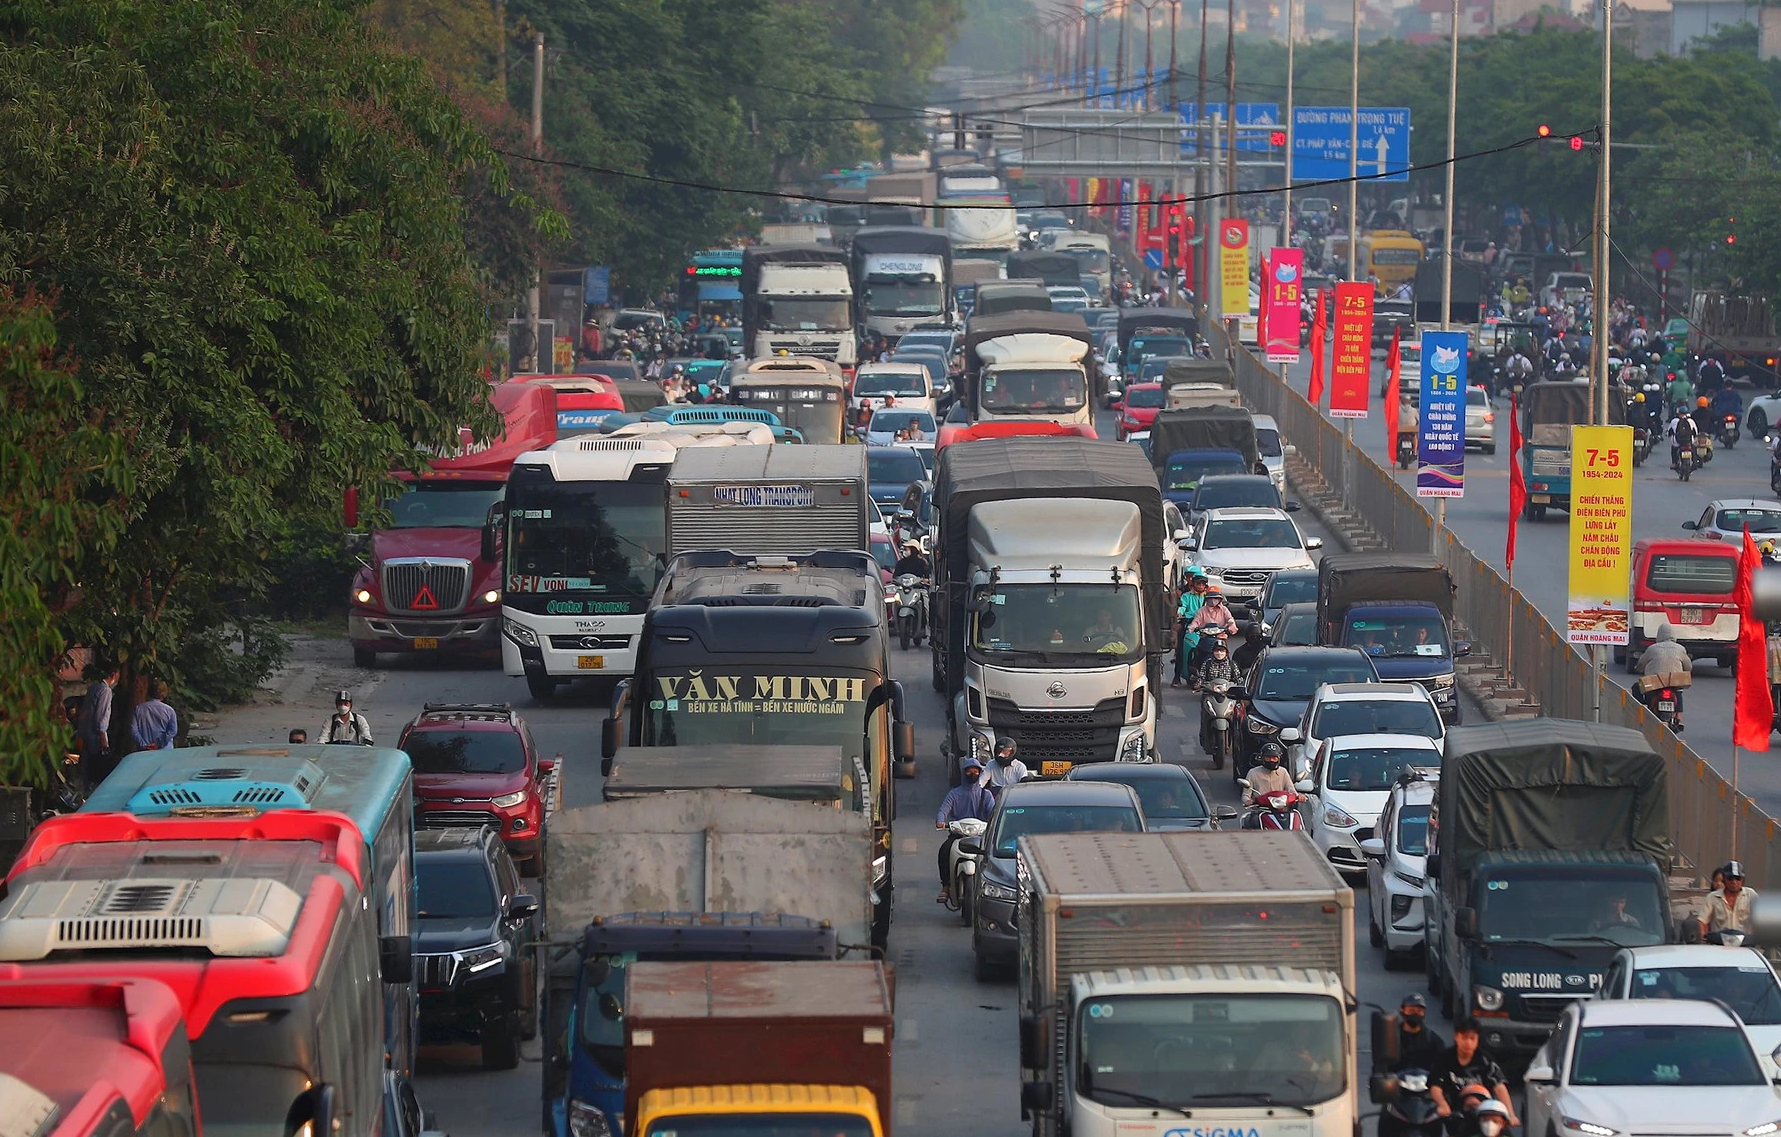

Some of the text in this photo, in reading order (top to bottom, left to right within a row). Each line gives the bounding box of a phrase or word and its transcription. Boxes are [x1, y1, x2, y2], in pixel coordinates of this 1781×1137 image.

[1384, 126, 1395, 134] km
[1335, 150, 1346, 160] km
[1274, 284, 1297, 300] 1-5
[1344, 296, 1365, 308] 7-5
[1431, 375, 1457, 390] 1-5
[1430, 402, 1455, 412] NHIỆT LIỆT
[1428, 412, 1457, 421] CHÀO MỪNG
[1425, 432, 1460, 440] NGÀY QUỐC TẾ
[1438, 442, 1452, 451] ĐỘNG
[1586, 449, 1619, 467] 7-5
[1582, 470, 1623, 479] 1954-2024
[1579, 493, 1624, 505] CHIẾN THẮNG
[1576, 506, 1626, 519] ĐIỆN BIÊN PHỦ
[1585, 520, 1617, 530] LỪNG LẪY
[1583, 533, 1618, 542] NĂM CHÂU
[1581, 544, 1620, 556] CHẤN ĐỘNG
[1584, 559, 1595, 569] ĐỊA
[1597, 558, 1611, 568] CẦU
[509, 574, 542, 593] SEV
[1571, 633, 1590, 642] QUẬN
[1591, 634, 1612, 642] HOÀNG
[656, 669, 866, 702] VĂN MINH
[688, 700, 705, 713] BẾN
[707, 702, 718, 713] XE
[720, 700, 732, 713] HÀ
[733, 700, 753, 713] TĨNH
[763, 700, 780, 713] BẾN
[782, 703, 793, 713] XE
[794, 700, 817, 713] NƯỚC
[818, 700, 844, 714] NGẦM
[1502, 972, 1531, 988] SONG
[1533, 973, 1561, 988] LONG
